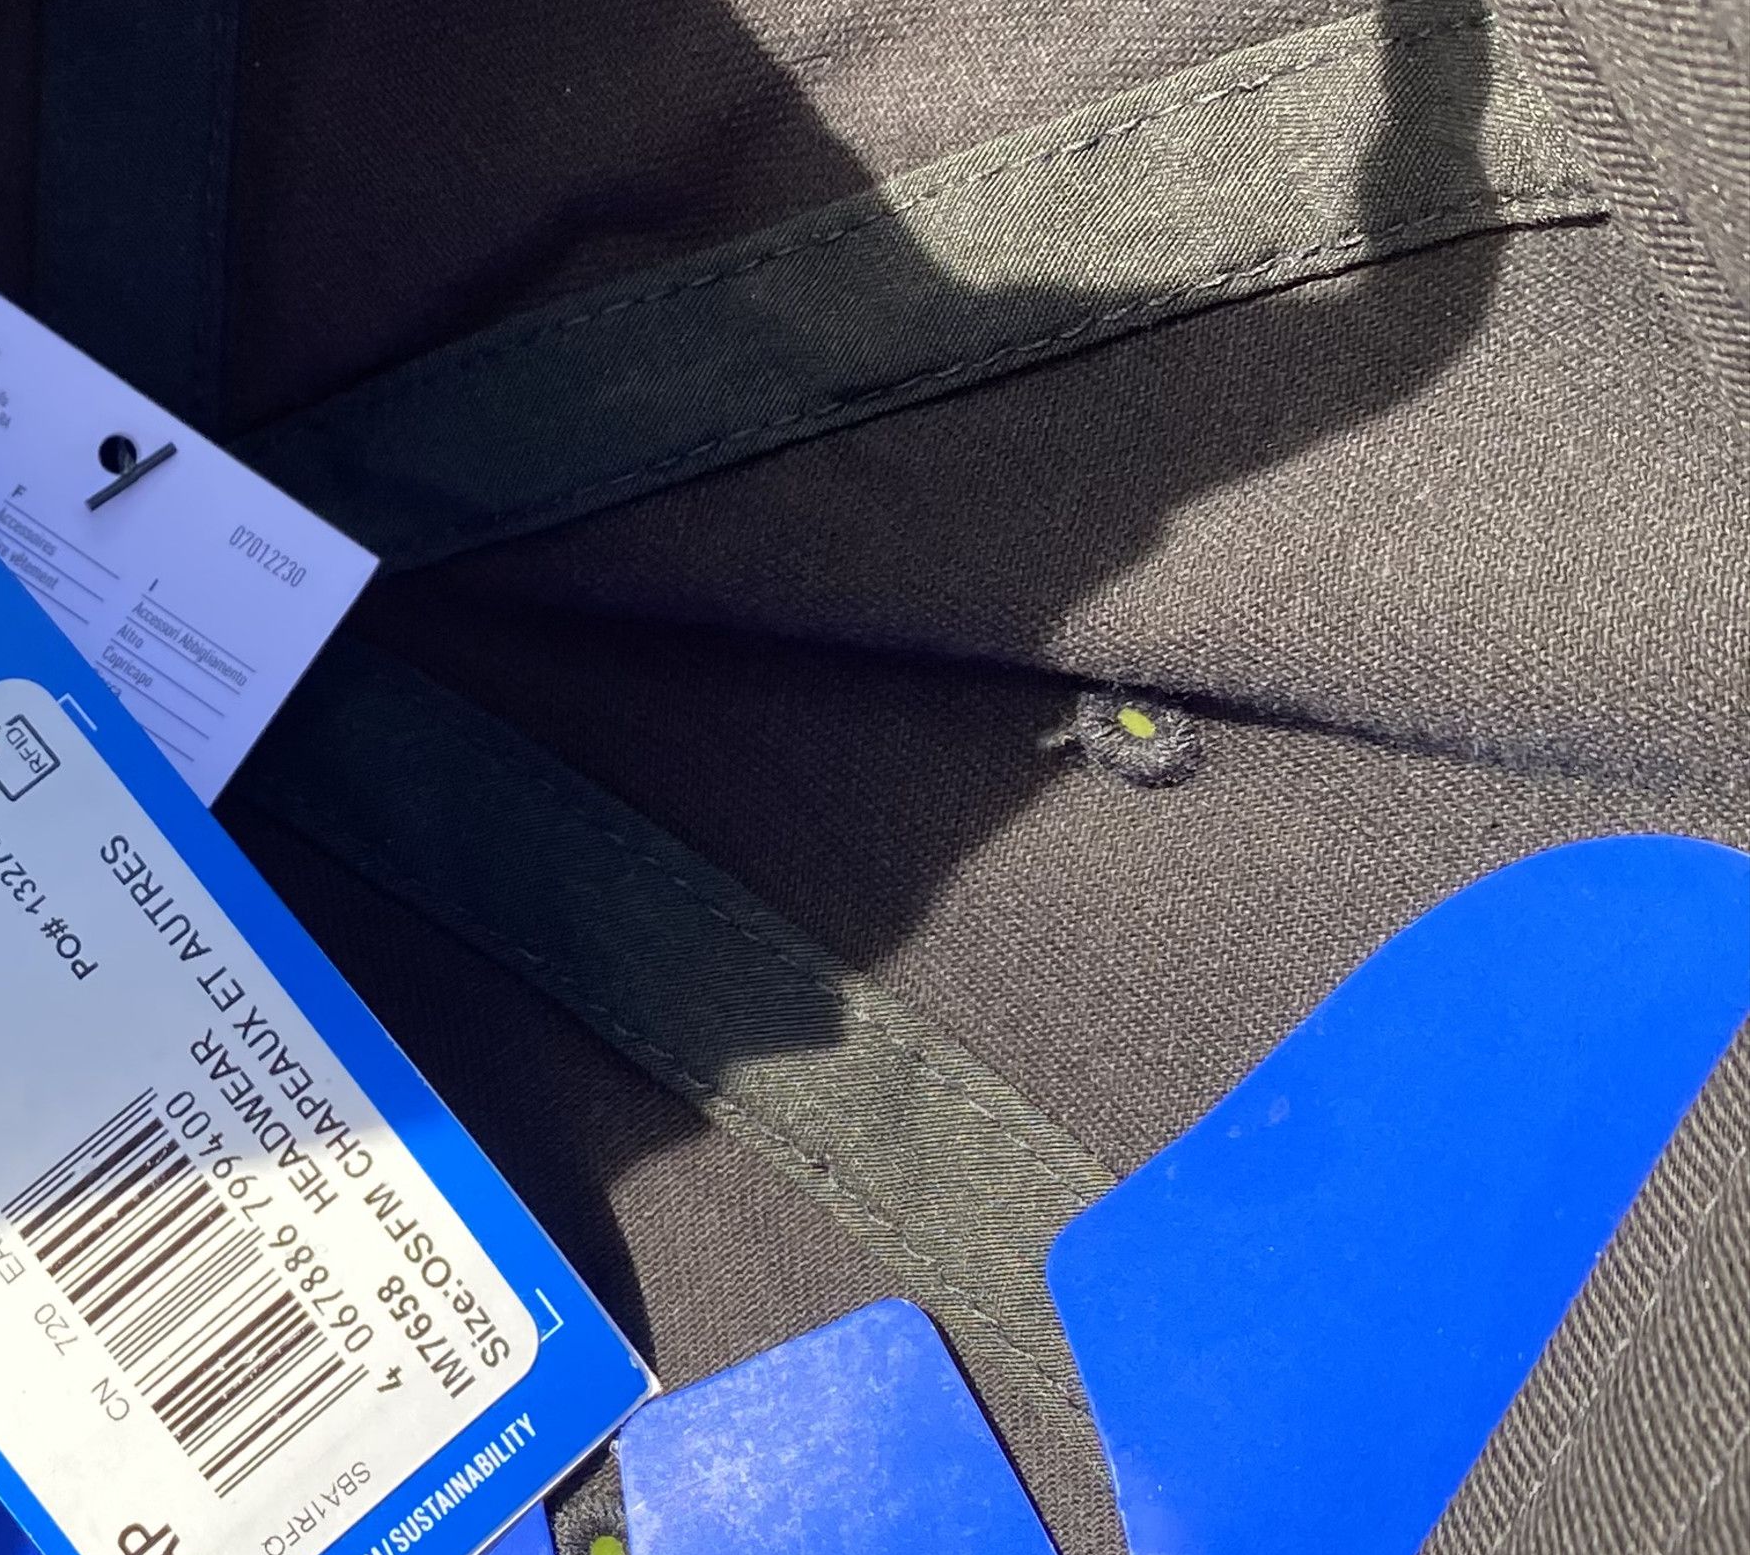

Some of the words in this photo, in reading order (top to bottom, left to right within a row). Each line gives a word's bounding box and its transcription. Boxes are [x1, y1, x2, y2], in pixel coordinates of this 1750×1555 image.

[228, 524, 307, 588] 07012230
[100, 644, 155, 689] Copricapo
[4, 718, 50, 776] RFID
[100, 835, 212, 962] AUTRES
[39, 917, 99, 981] PO#
[196, 966, 246, 1013] ET
[189, 1027, 339, 1214] HEADWEAR
[232, 1004, 373, 1179] CHAPEAUX
[164, 1090, 273, 1222] 799400
[268, 1224, 374, 1353] 067886
[363, 1182, 511, 1368] Size:OSFM
[32, 1301, 80, 1358] 720
[376, 1275, 476, 1399] IM7658
[89, 1375, 132, 1423] CN
[375, 1365, 404, 1394] 4
